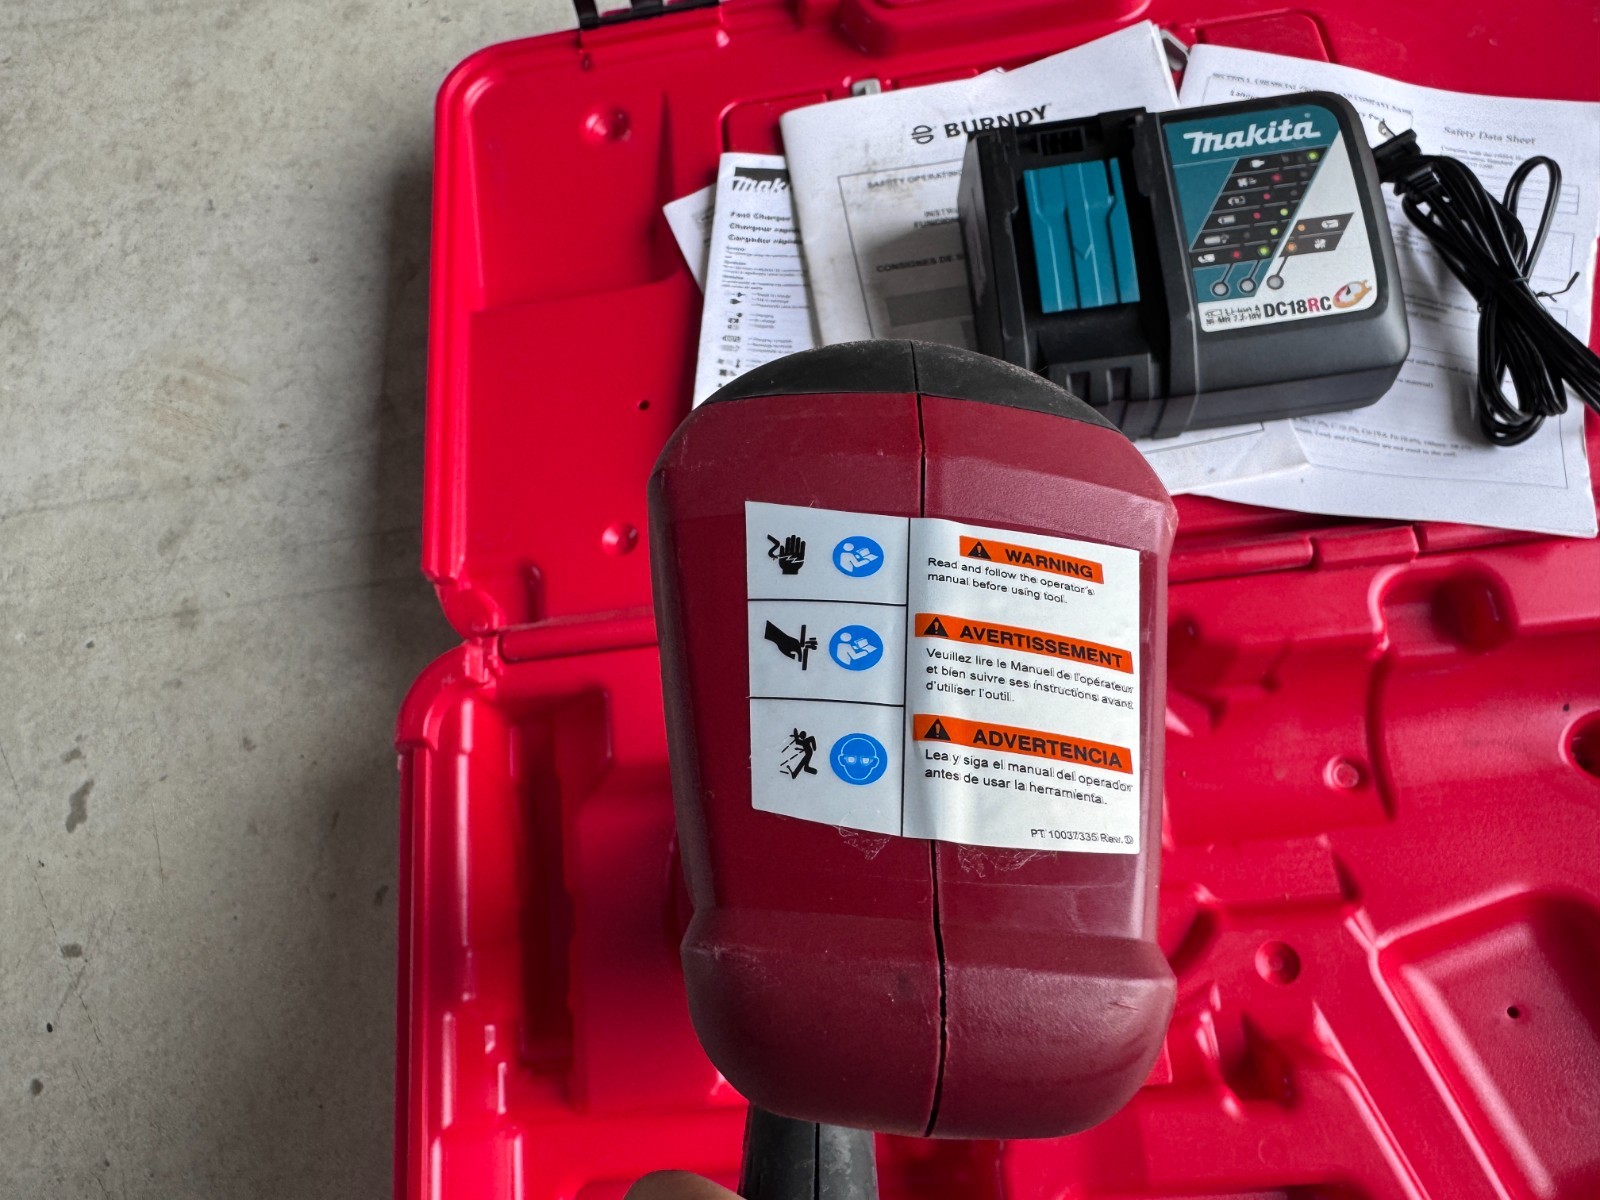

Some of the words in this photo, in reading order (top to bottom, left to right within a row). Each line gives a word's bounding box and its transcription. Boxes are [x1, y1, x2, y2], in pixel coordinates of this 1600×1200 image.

[944, 104, 1048, 139] BURNDY
[1443, 127, 1476, 141] Safety
[1479, 131, 1503, 143] Data
[1505, 135, 1537, 146] Sheet
[1263, 295, 1333, 319] DC18RC
[927, 557, 959, 570] Read
[961, 562, 982, 575] and
[985, 566, 1017, 580] follow
[1019, 572, 1037, 584] the
[1040, 577, 1095, 597] operator's
[1004, 548, 1094, 579] WARNING
[927, 573, 970, 586] manual
[972, 578, 1008, 593] before
[1011, 587, 1041, 601] using
[1043, 591, 1069, 604] tool.
[959, 624, 1123, 669] AVERTISSEMENT
[926, 647, 972, 665] Veuillez
[975, 654, 994, 668] lire
[996, 658, 1008, 670] le
[1010, 661, 1055, 679] Manuel
[1057, 667, 1071, 680] de
[1074, 672, 1134, 695] l'opérateur
[926, 665, 939, 676] et
[941, 666, 966, 680] bien
[969, 672, 1006, 686] suivre
[1008, 678, 1031, 689] ses
[1033, 679, 1100, 702] instructions
[1101, 696, 1134, 710] avant
[925, 680, 976, 697] d'utiliser
[978, 687, 1015, 703] l'outil.
[972, 728, 1124, 769] ADVERTENCIA
[924, 767, 960, 781] antes
[963, 772, 980, 785] de
[983, 776, 1011, 789] usar
[1014, 778, 1028, 792] la
[1029, 782, 1108, 805] herramienta.
[925, 749, 950, 762] Lea
[952, 752, 961, 766] y
[963, 755, 989, 770] siga
[992, 759, 1006, 770] el
[1008, 761, 1055, 779] manual
[1056, 768, 1077, 782] del
[1078, 773, 1134, 793] operador
[1030, 828, 1047, 839] PT
[1048, 830, 1099, 843] 10037335
[1100, 832, 1124, 845] Rev.
